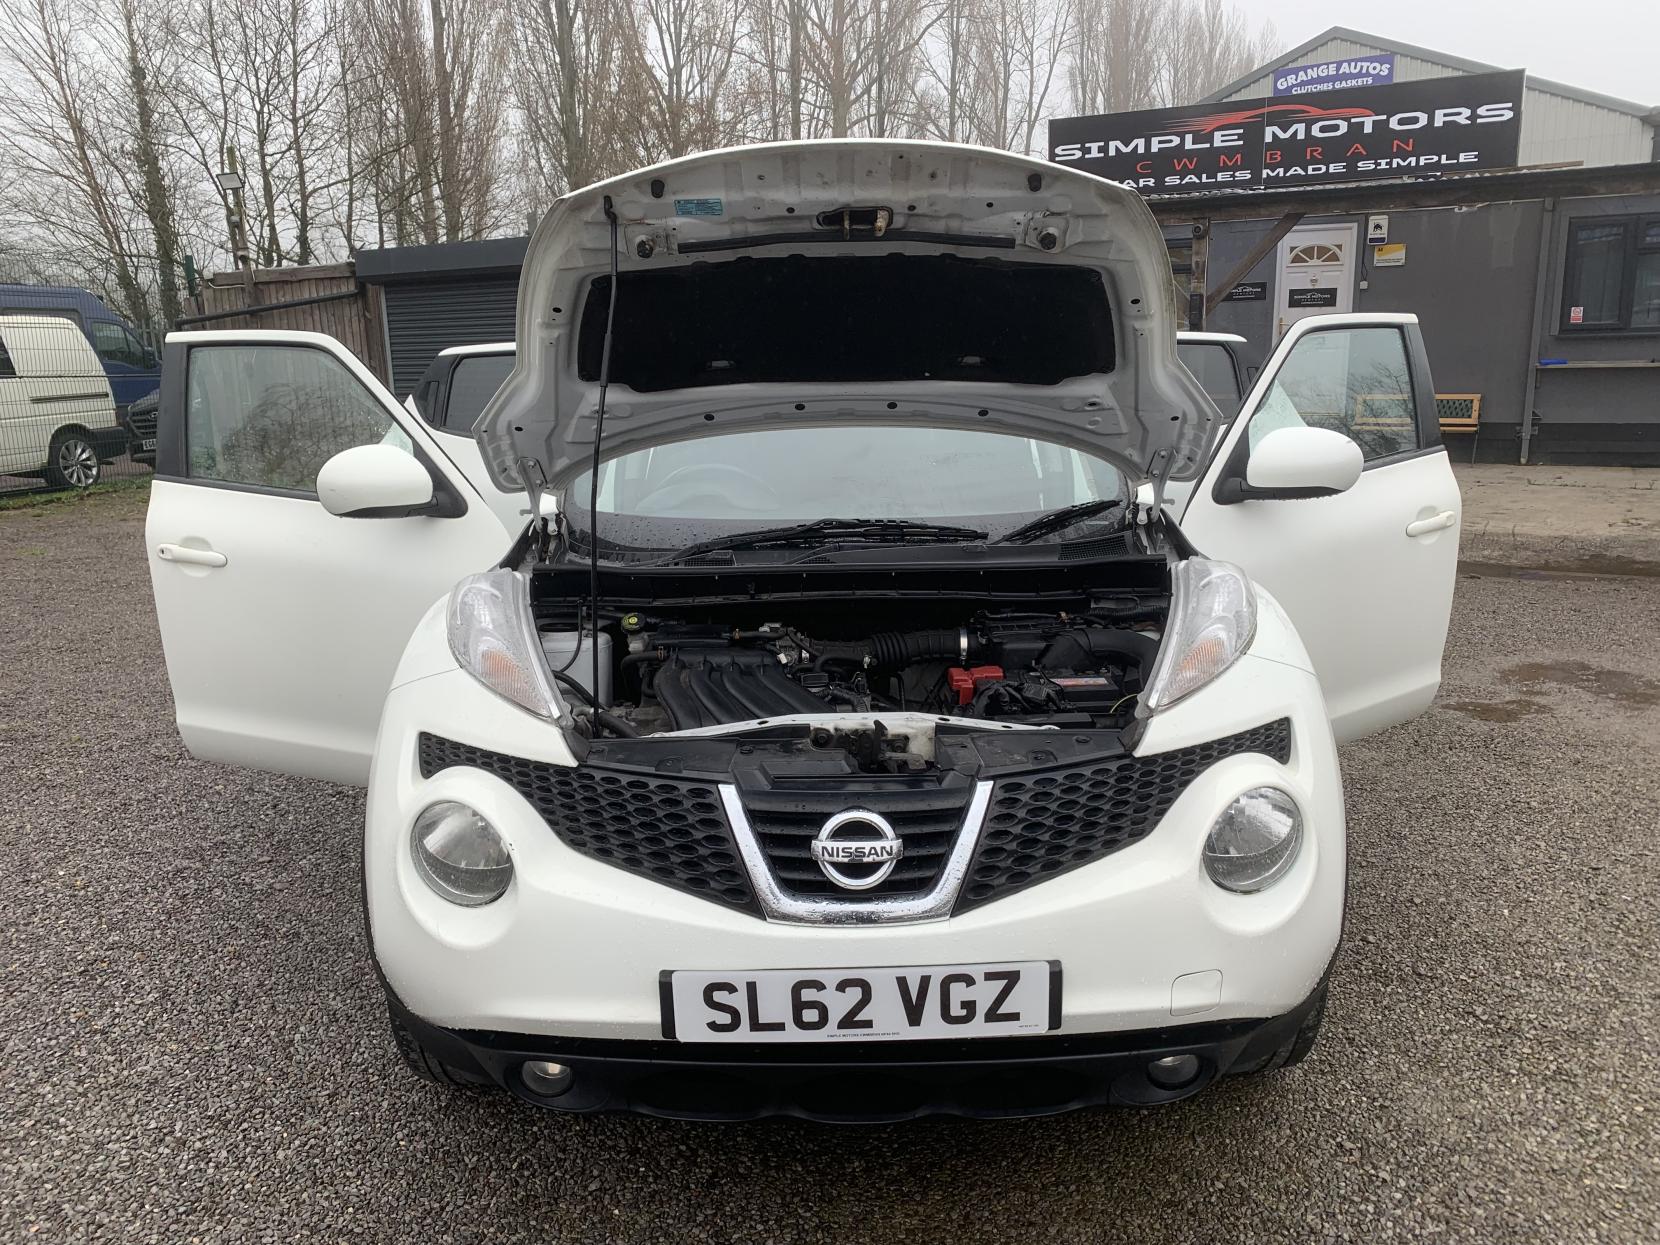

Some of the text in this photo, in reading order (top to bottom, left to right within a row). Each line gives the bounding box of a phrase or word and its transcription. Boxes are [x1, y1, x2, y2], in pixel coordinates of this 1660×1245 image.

[1276, 62, 1391, 90] GRANGE AUTOS
[1292, 76, 1373, 95] CLUTCHES GASKETS
[1054, 102, 1514, 161] SIMPLE MOTORS
[1113, 151, 1479, 188] AR SALES MADE SIMPLE
[821, 844, 894, 858] NISSAN
[702, 970, 1021, 1033] SL62 VGZ
